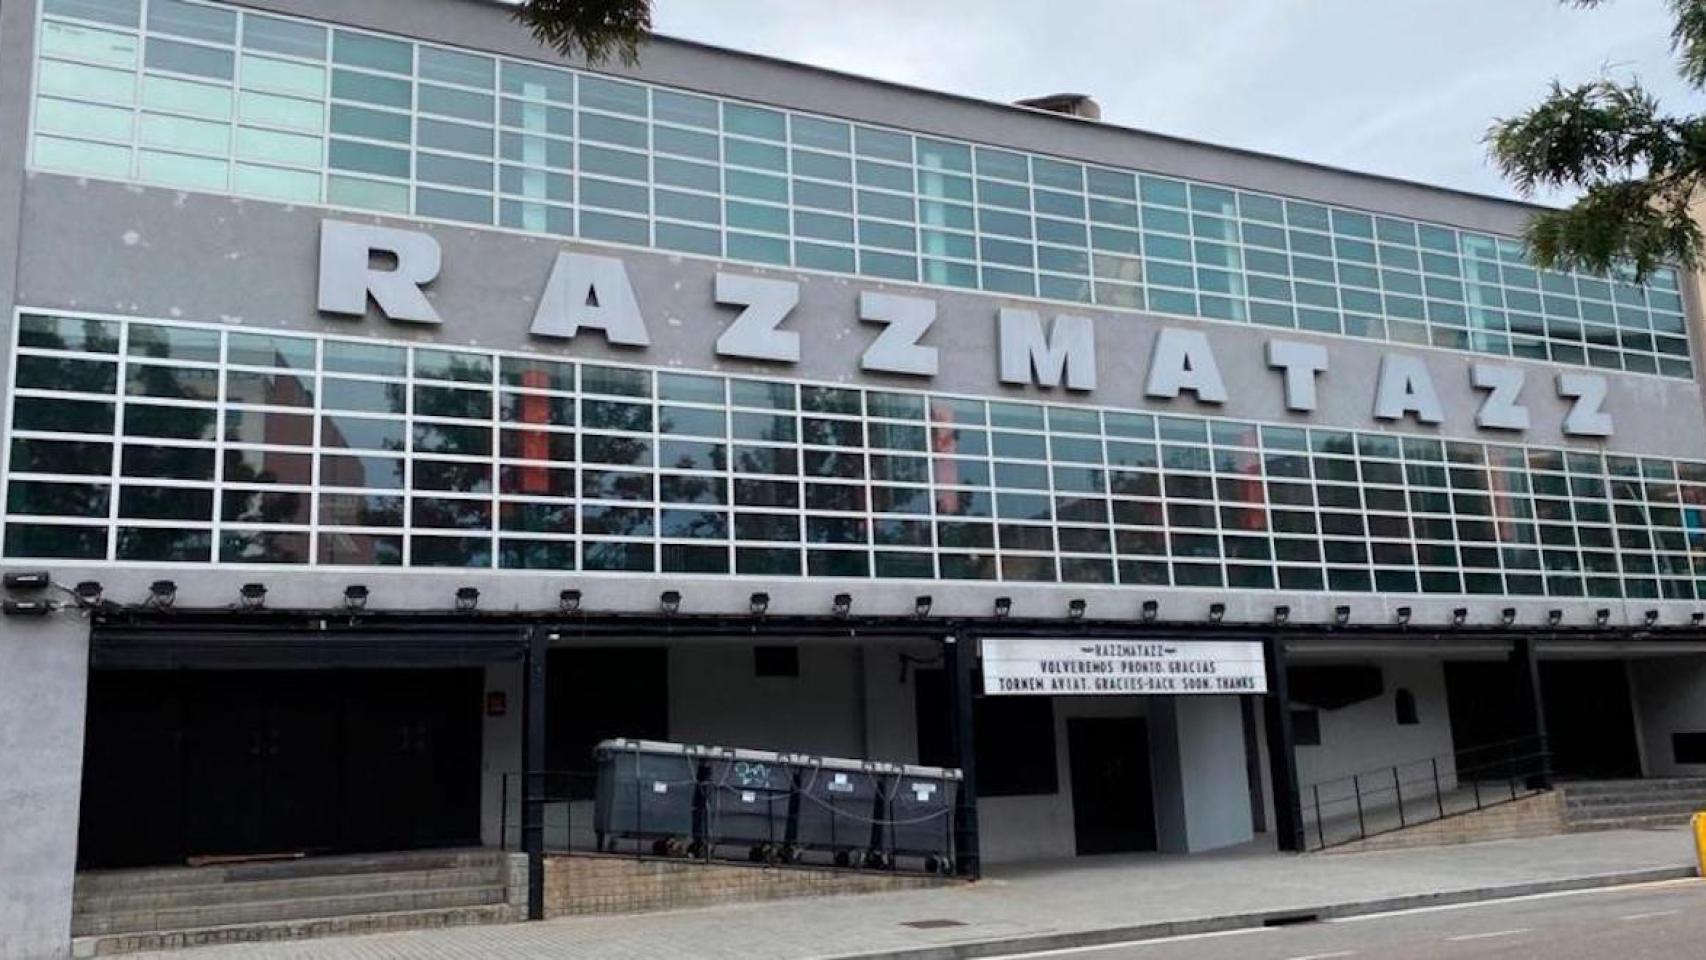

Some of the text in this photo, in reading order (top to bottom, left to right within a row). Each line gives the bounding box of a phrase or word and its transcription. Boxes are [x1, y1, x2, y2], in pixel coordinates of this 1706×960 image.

[318, 217, 1614, 437] RAZZMATAZZ
[1094, 643, 1163, 657] RAZZMATAZZ
[1040, 661, 1114, 673] VOLVEREMOS
[1168, 661, 1216, 673] GRACIAS
[999, 677, 1044, 690] TORNEM
[1216, 676, 1255, 689] THANKS
